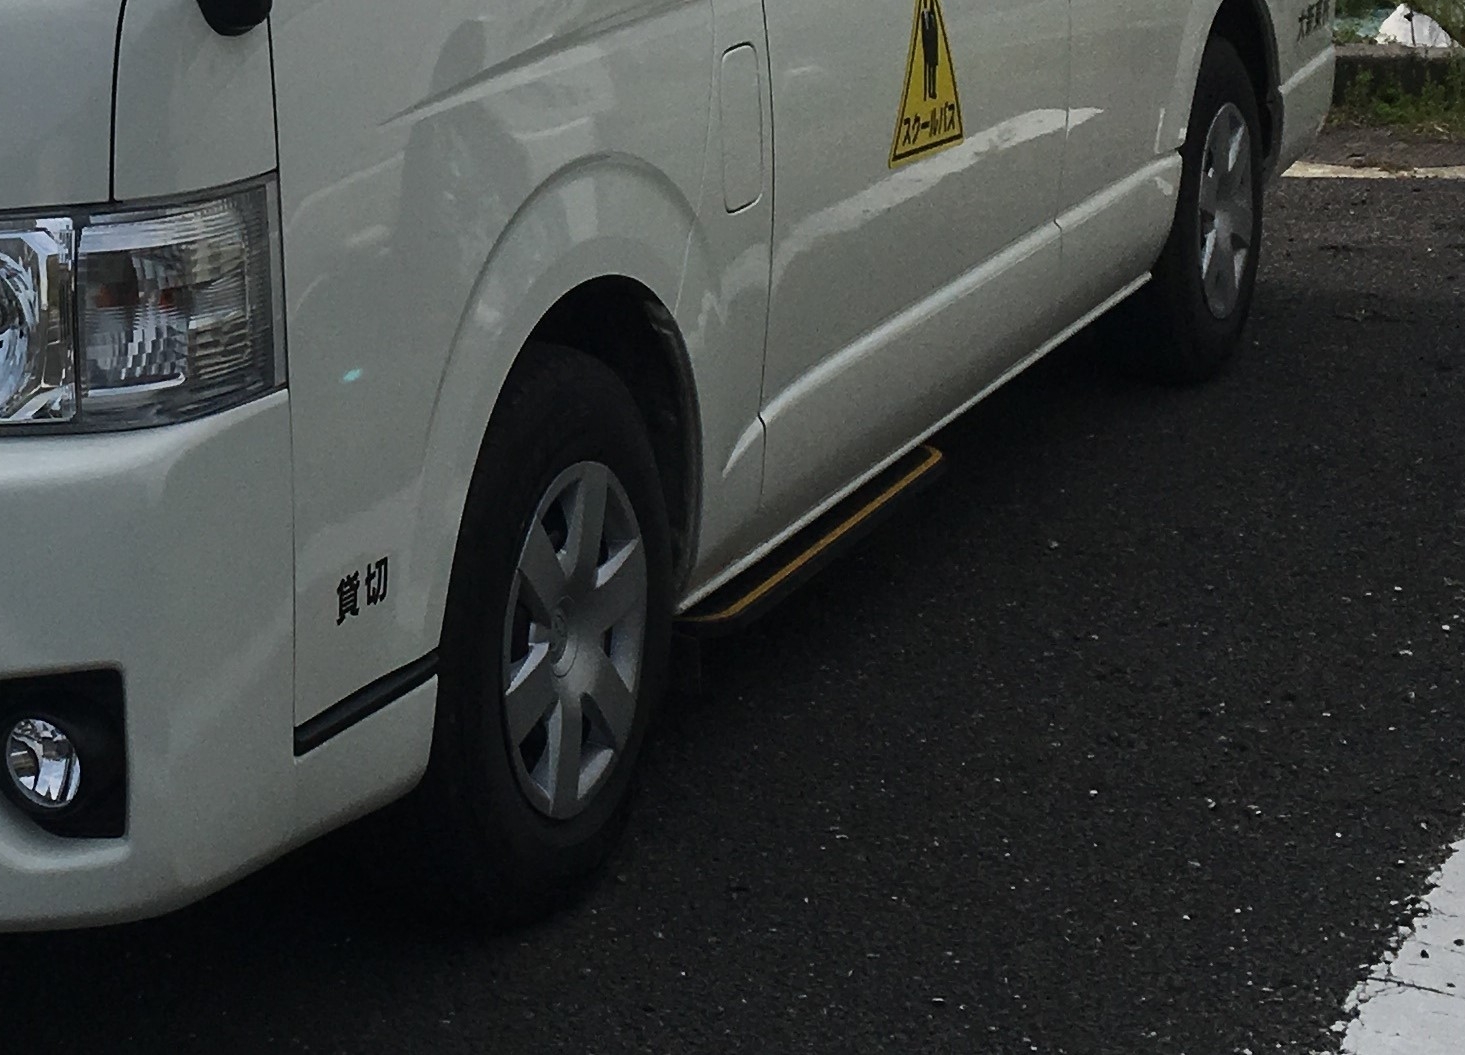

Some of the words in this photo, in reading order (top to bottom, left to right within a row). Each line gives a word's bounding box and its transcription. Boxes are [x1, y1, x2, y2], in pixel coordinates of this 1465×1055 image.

[902, 101, 955, 146] スクールバス
[336, 556, 388, 626] 貸切
